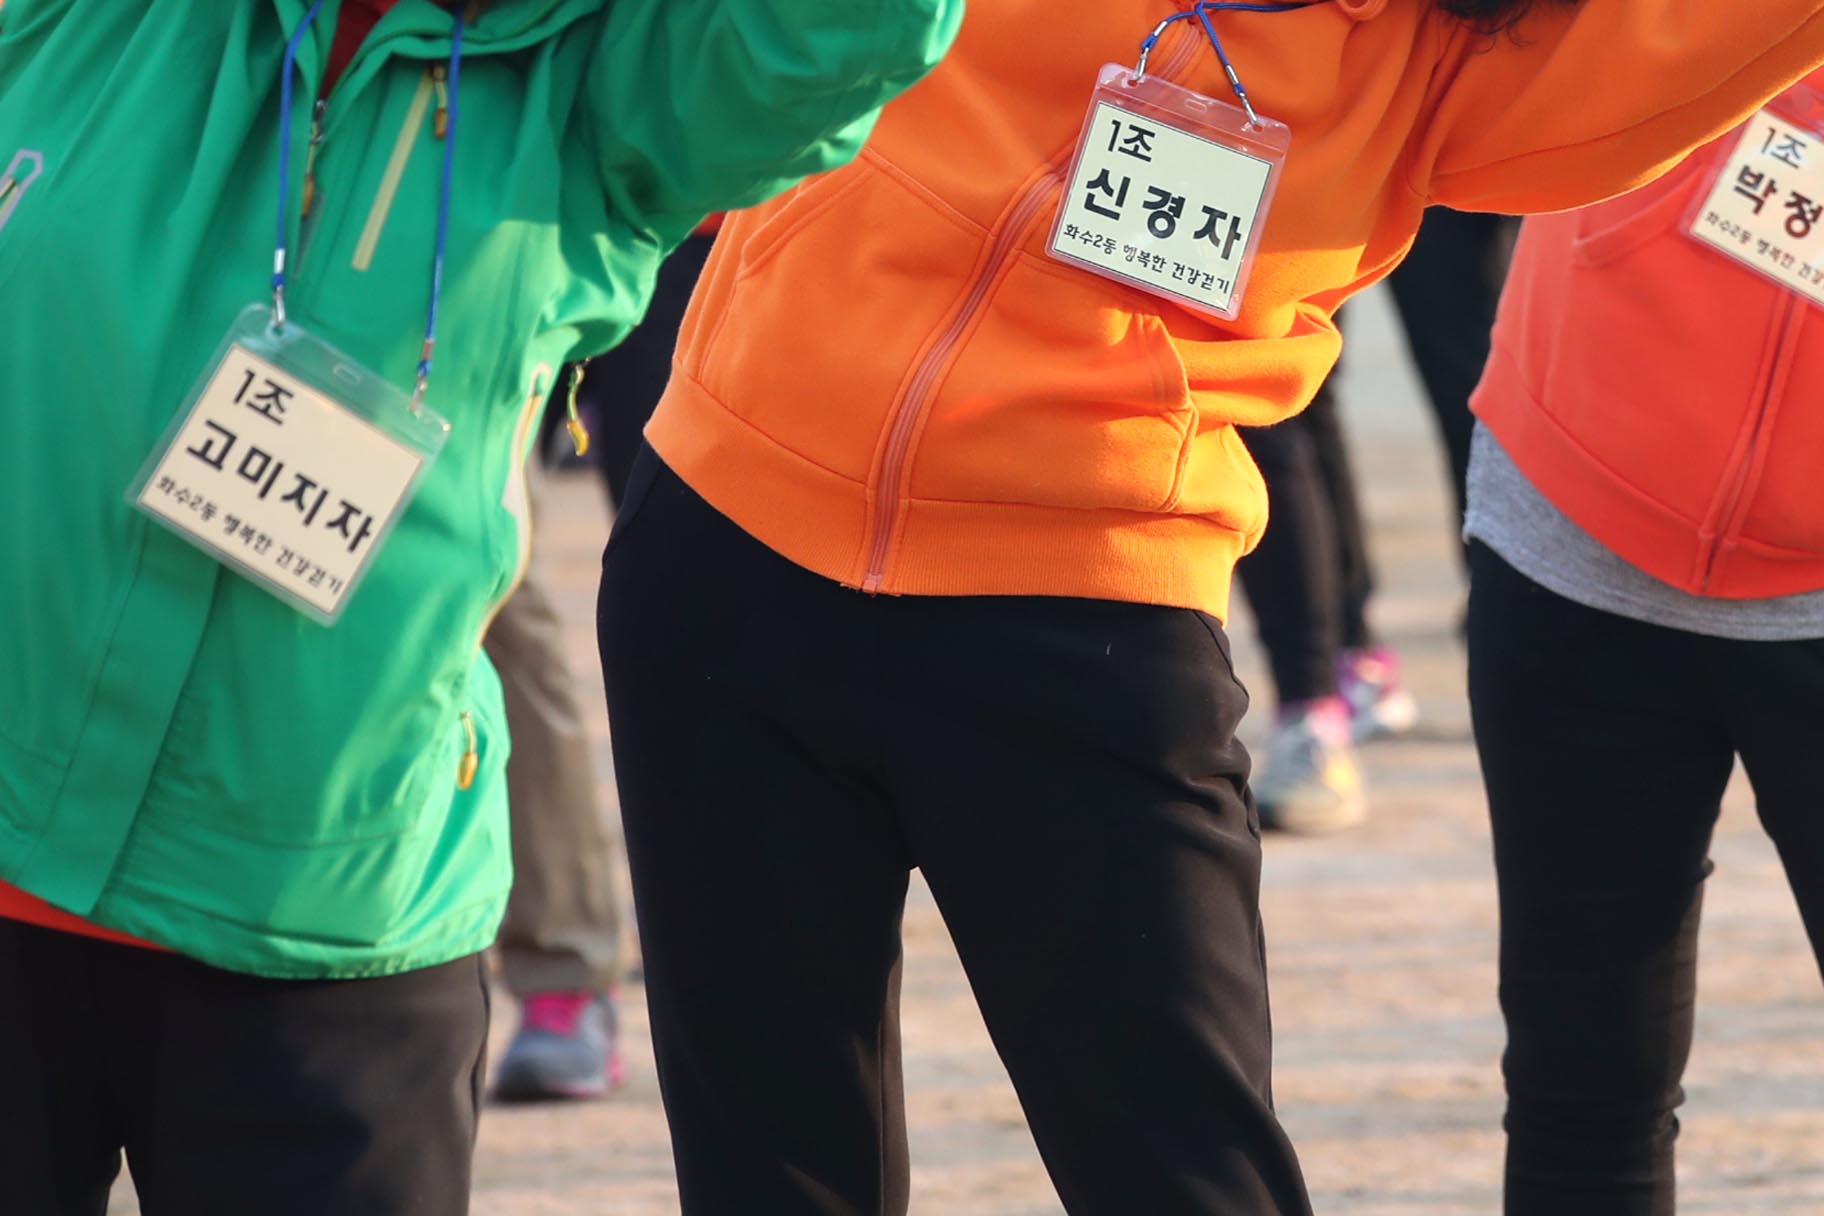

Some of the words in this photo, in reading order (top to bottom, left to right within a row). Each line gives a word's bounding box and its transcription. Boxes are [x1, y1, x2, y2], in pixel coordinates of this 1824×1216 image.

[1108, 119, 1156, 162] 1조
[1761, 127, 1807, 169] 1조
[1083, 168, 1242, 260] 신경자
[1064, 223, 1117, 256] 화수2동
[1123, 243, 1168, 274] 행복한
[1172, 262, 1230, 294] 건강걷기
[233, 369, 294, 425] 1조
[186, 419, 373, 553] 고미지자
[156, 475, 218, 522] 화수2동
[223, 513, 274, 555] 행복한
[276, 548, 344, 595] 건강걷기
